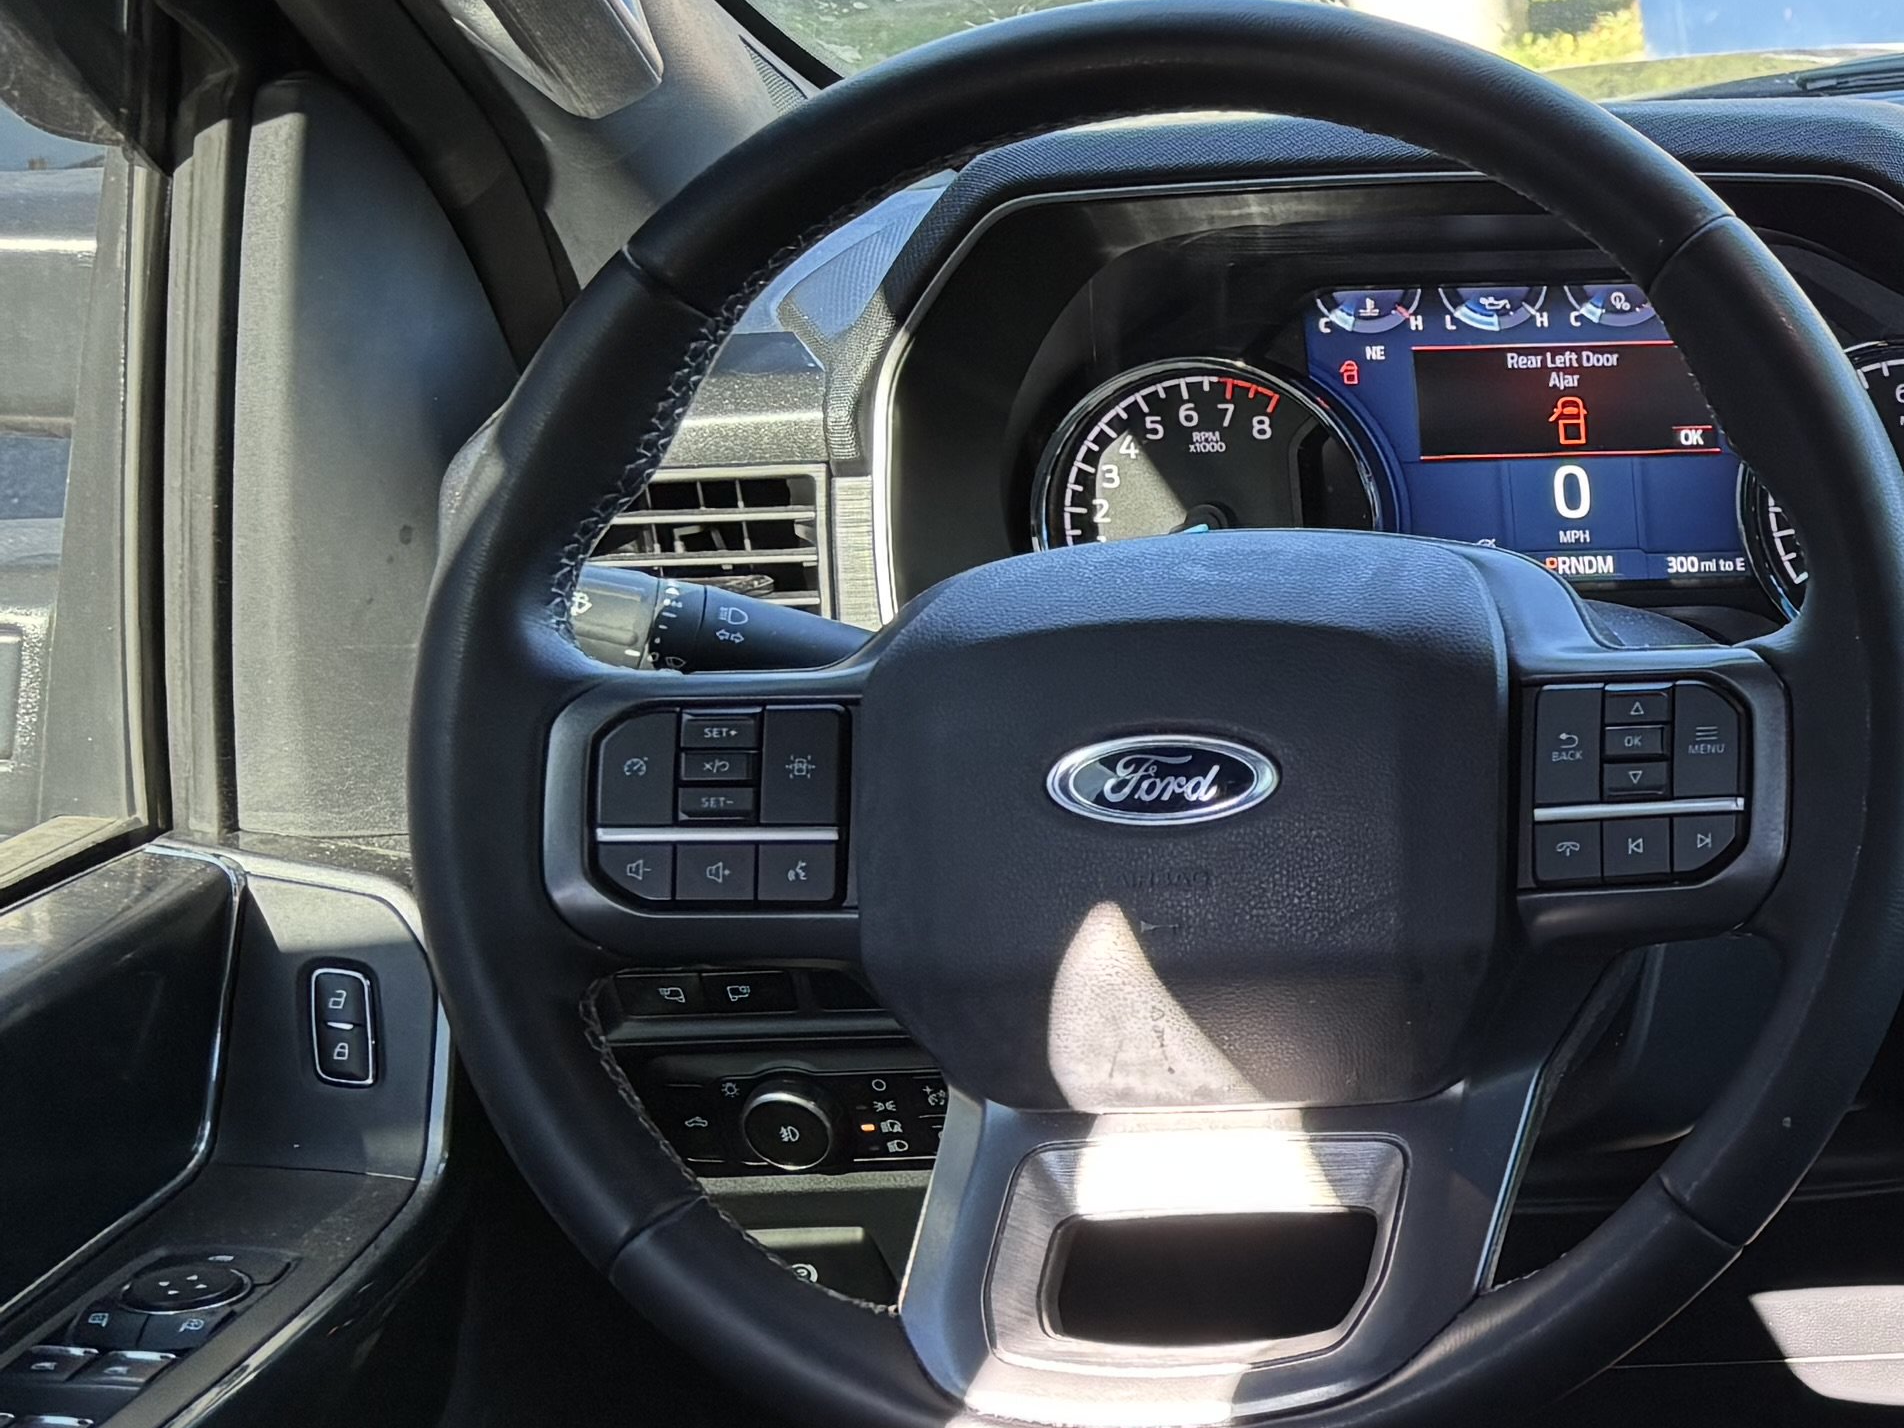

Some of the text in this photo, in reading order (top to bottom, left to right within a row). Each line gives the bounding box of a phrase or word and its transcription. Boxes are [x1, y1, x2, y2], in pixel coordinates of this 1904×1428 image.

[1319, 319, 1331, 333] C
[1409, 316, 1424, 331] H
[1445, 315, 1457, 330] L
[1535, 313, 1549, 328] H
[1569, 312, 1581, 327] C
[1366, 346, 1386, 361] NE
[1507, 351, 1620, 369] Rear Left Door
[1548, 372, 1581, 390] Ajar
[1178, 403, 1199, 428] 6
[1217, 404, 1236, 427] 7
[1145, 415, 1164, 440] 5
[1252, 415, 1272, 440] 8
[1192, 431, 1220, 442] RPM
[1119, 435, 1139, 459] 4
[1101, 464, 1121, 489] 3
[1552, 464, 1591, 519] 0
[1092, 499, 1112, 523] 2
[1558, 529, 1590, 544] MPH
[1667, 556, 1698, 574] 300
[1719, 557, 1734, 572] to
[1736, 556, 1746, 572] E
[703, 726, 738, 739] SET+
[1624, 735, 1643, 747] OK
[1688, 743, 1726, 755] MENU
[1551, 749, 1583, 762] BACK
[1103, 753, 1221, 803] Ford
